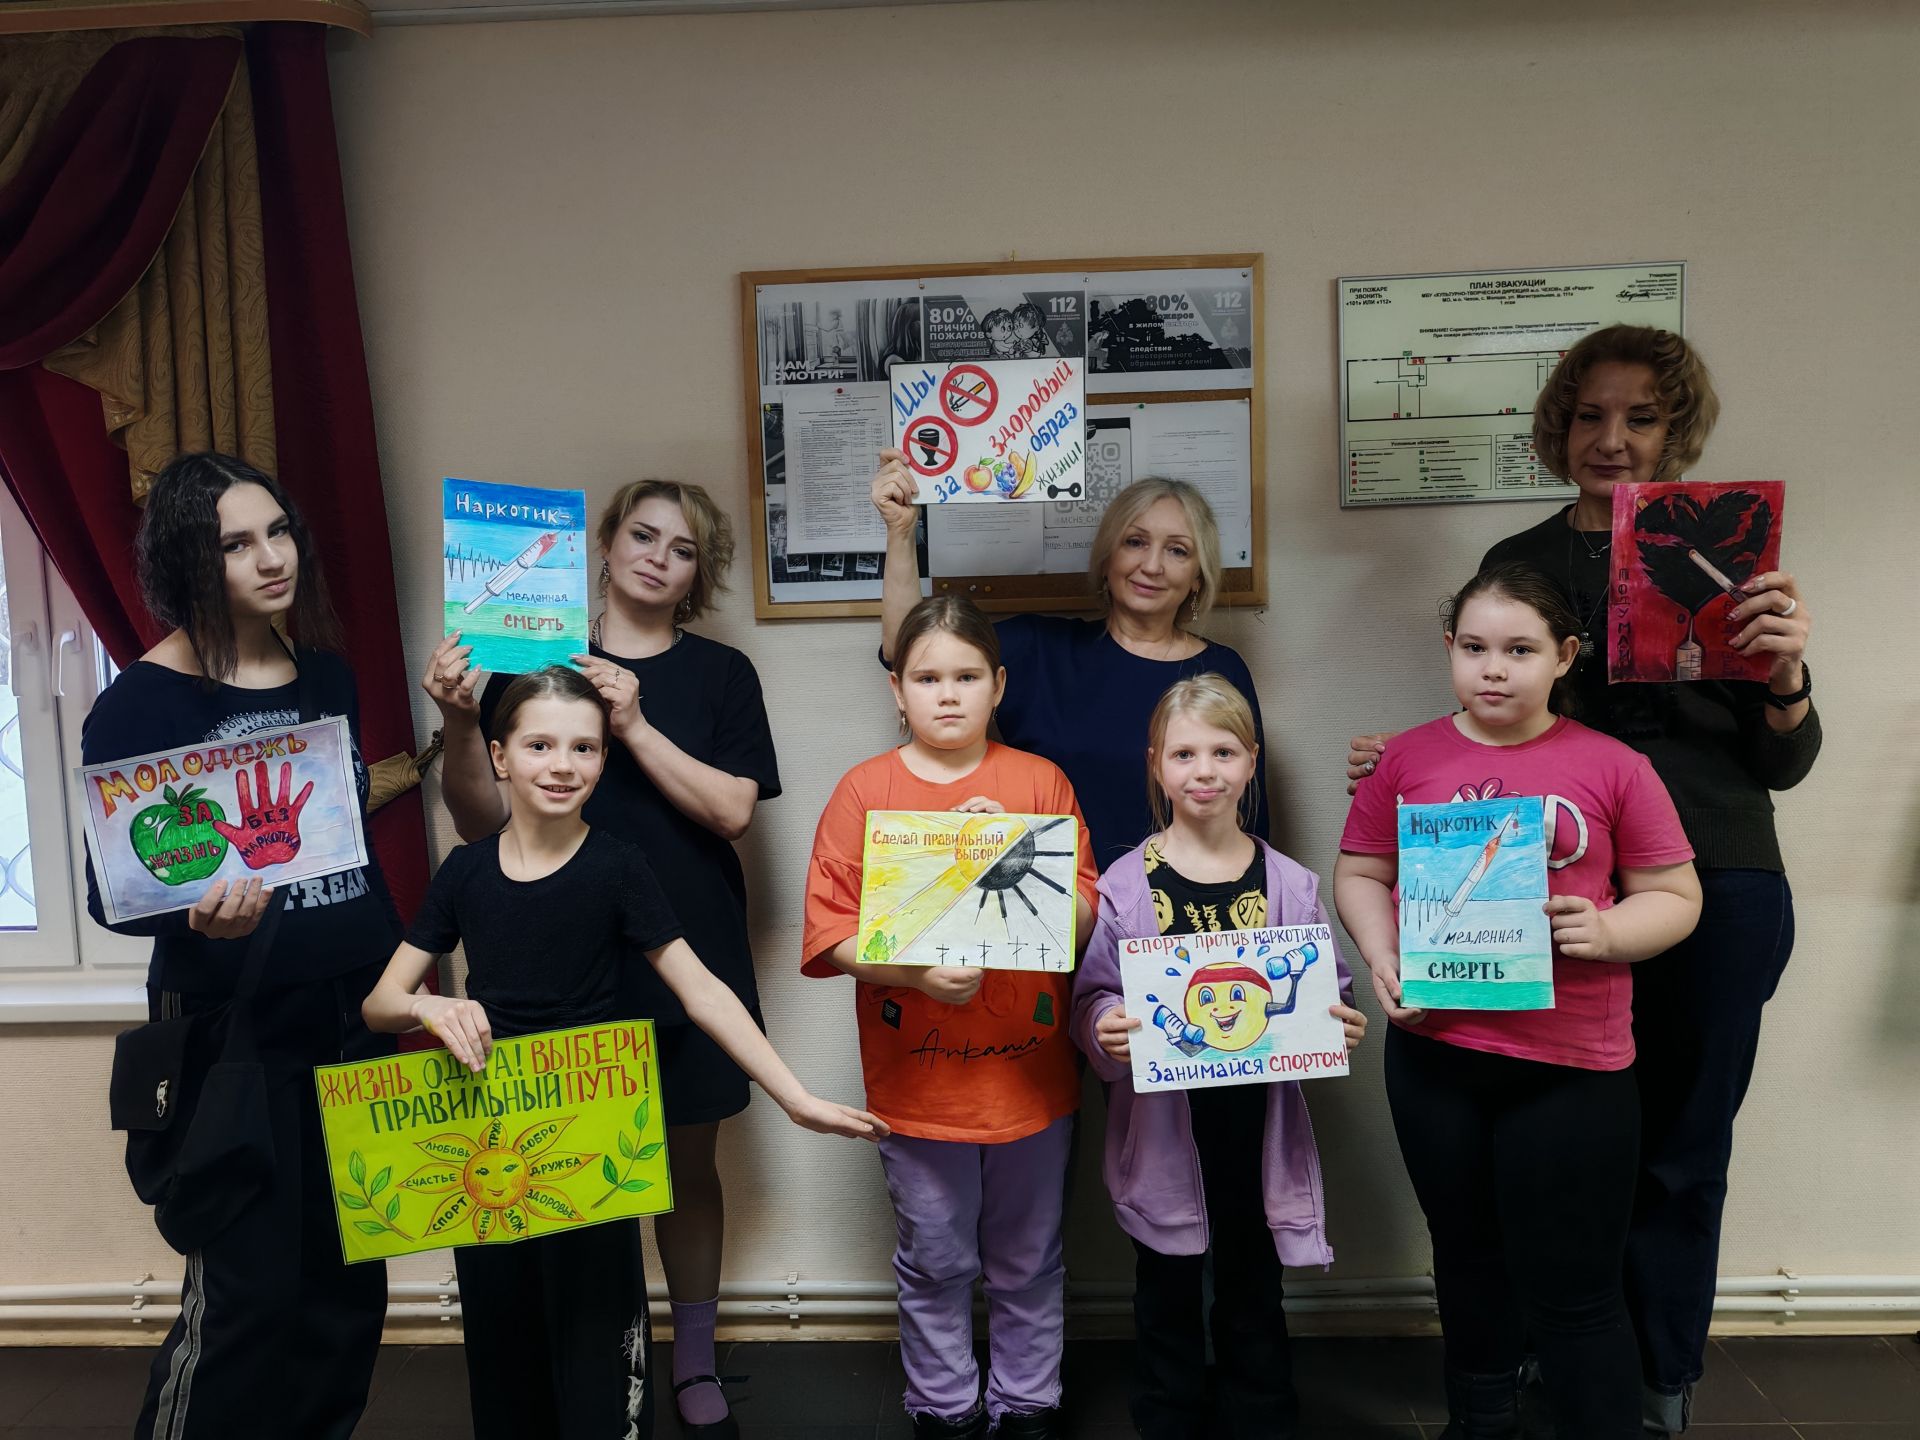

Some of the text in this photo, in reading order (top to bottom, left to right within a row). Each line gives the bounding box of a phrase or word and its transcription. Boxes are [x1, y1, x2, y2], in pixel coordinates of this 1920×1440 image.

[1469, 279, 1546, 290] ПЛАН ЭВАКУАЦИИ
[1049, 296, 1077, 313] 112
[1145, 294, 1189, 311] 80%
[1213, 291, 1242, 308] 112
[929, 307, 974, 324] 80%
[1151, 312, 1195, 321] пожаров
[929, 324, 975, 333] ПРИЧИН
[929, 331, 985, 341] ПОЖАРОВ
[1129, 345, 1173, 353] следствие
[771, 369, 845, 381] СМОТРИ!
[503, 613, 565, 631] СМЕРТЬ
[177, 801, 214, 827] ЗА
[246, 807, 291, 830] БЕЗ
[1410, 811, 1498, 844] Наркотик
[872, 830, 918, 846] Сделай
[149, 840, 222, 870] ЖИЗНЬ
[320, 1062, 413, 1108] ЖИЗНЬ
[530, 1026, 651, 1074] ВЫБЕРИ
[1147, 1057, 1264, 1084] Занимайся
[368, 1061, 651, 1134] ПРАВИЛЬНЫЙ ПУТЬ!
[519, 1124, 558, 1155] ДОБРО
[425, 1142, 472, 1158] ЛЮБОВЬ
[529, 1156, 582, 1177] ДРУЖБА
[406, 1172, 457, 1187] СЧАСТЬЕ
[525, 1188, 577, 1219] ЗДОРОВЬЕ
[432, 1195, 469, 1231] СПОРТ
[503, 1209, 527, 1233] ЗОЖ
[478, 1210, 493, 1240] СЕМЬЯ
